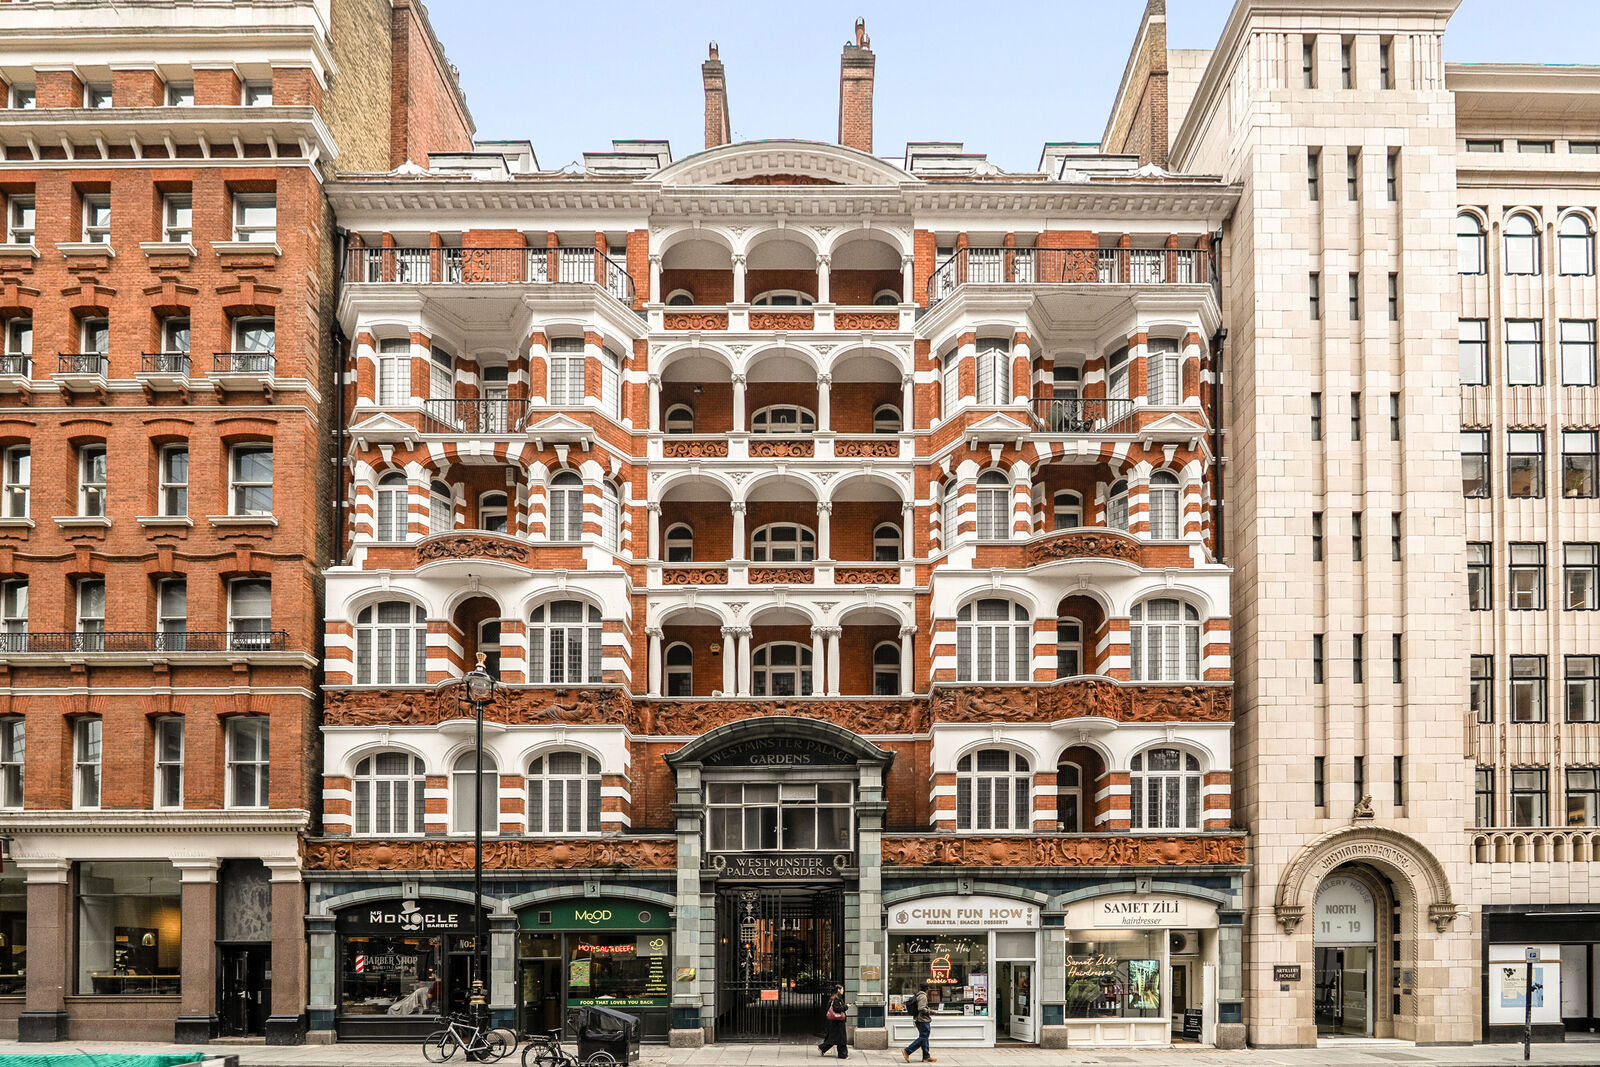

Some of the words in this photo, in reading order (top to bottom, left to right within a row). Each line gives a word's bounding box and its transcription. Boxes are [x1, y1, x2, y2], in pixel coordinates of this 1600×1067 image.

[710, 740, 801, 763] WESTMINSTER
[807, 742, 851, 763] PALACE
[750, 754, 810, 764] GARDENS
[736, 858, 823, 867] WESTMINSTER
[726, 867, 771, 876] PALACE
[775, 867, 832, 876] GARDENS
[408, 886, 412, 894] 1
[590, 885, 596, 893] 3
[962, 882, 968, 890] 5
[1141, 881, 1146, 889] 7
[1350, 881, 1371, 905] HOUSE
[1104, 902, 1150, 913] SAMET
[1325, 904, 1357, 914] NORTH
[912, 909, 951, 919] CHUN
[957, 909, 983, 919] FUN
[989, 909, 1023, 919] HOW
[1121, 917, 1162, 925] hairdresser
[1321, 921, 1330, 933] 11
[1348, 921, 1360, 933] 19
[578, 944, 594, 952] HOT
[615, 944, 631, 953] BEEF
[909, 943, 931, 954] Chun
[934, 943, 951, 954] Fun
[1065, 955, 1093, 967] Samet
[1067, 966, 1114, 977] Hairdresser
